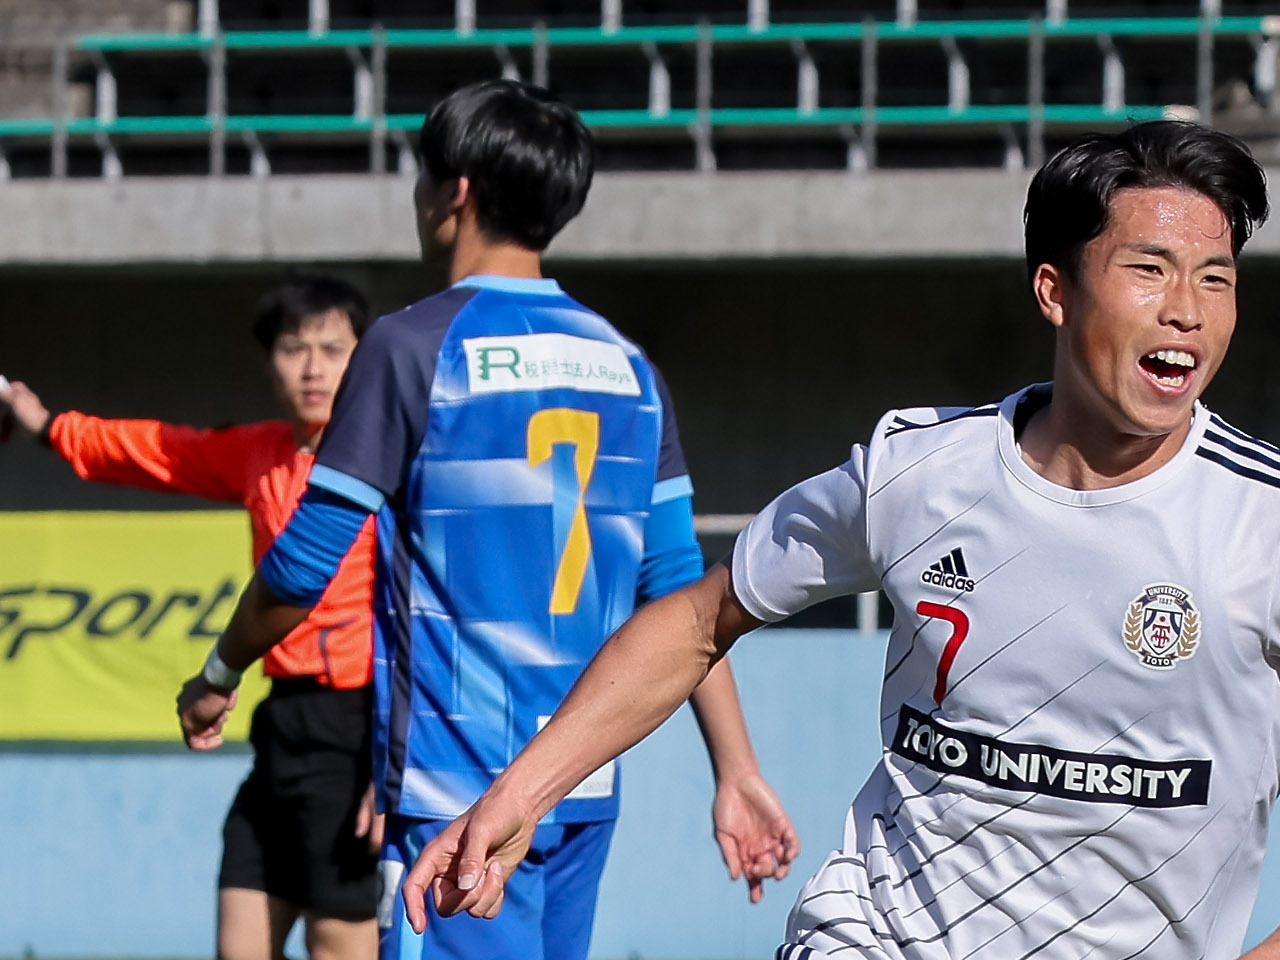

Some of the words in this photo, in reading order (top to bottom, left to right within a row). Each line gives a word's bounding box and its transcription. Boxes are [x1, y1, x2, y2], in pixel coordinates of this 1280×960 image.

[527, 407, 600, 614] 7
[921, 570, 976, 593] adidas
[916, 600, 969, 706] 7
[1146, 655, 1171, 666] TOYO
[902, 718, 969, 768] TOYO
[980, 744, 1192, 799] UNIVERSITY
